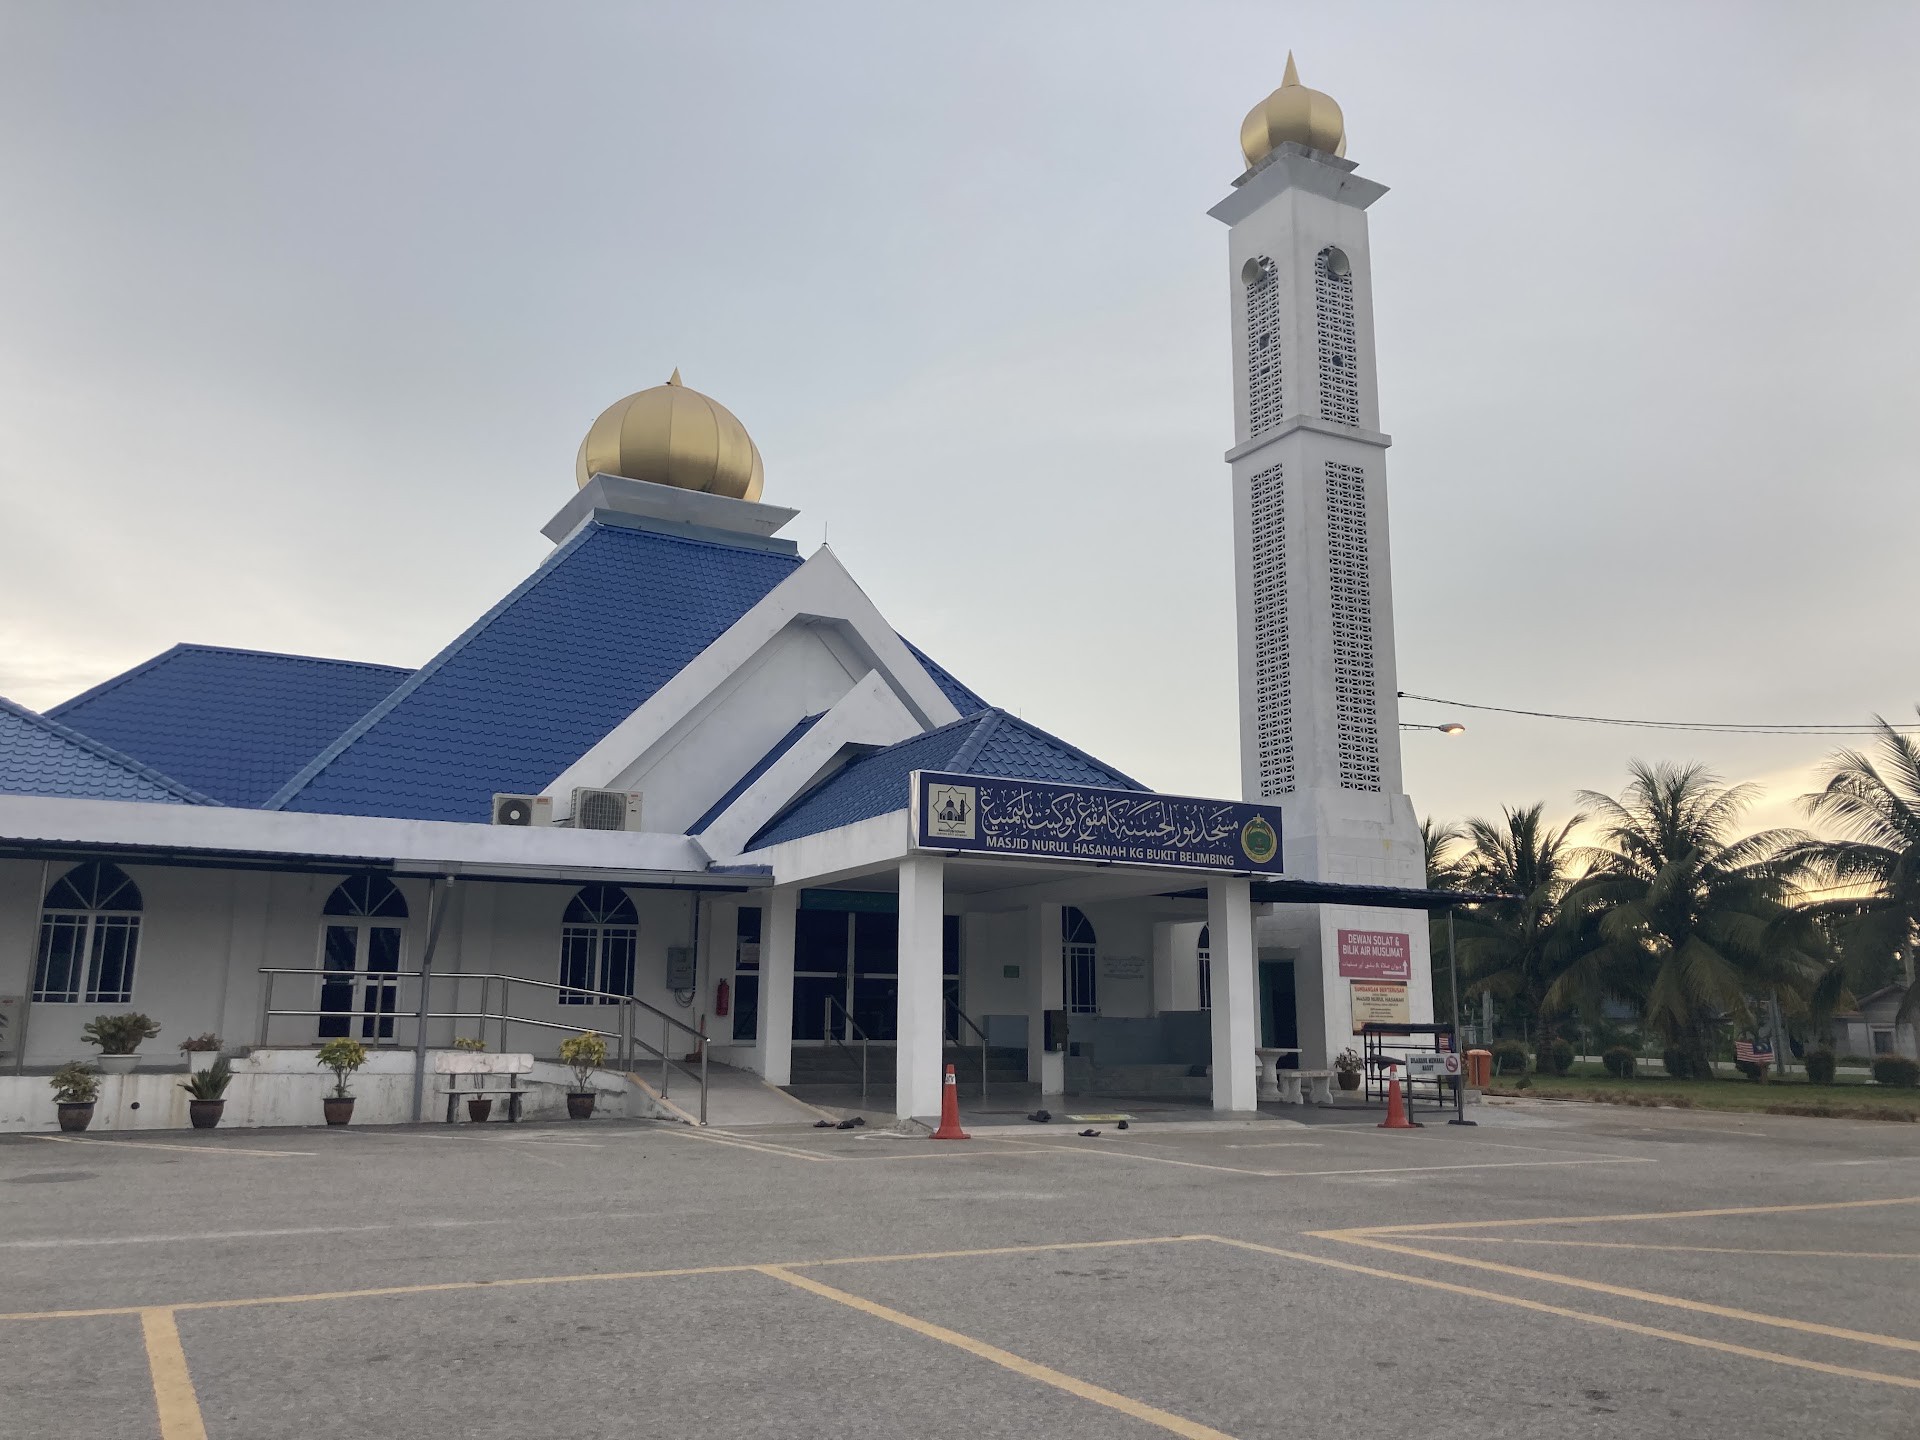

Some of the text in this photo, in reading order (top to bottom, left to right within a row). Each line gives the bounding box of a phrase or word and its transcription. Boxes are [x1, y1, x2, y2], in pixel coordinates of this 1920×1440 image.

[986, 835, 1235, 866] MASJID NURUL HASANAH KG BUKIT BELIMBING
[1348, 933, 1400, 947] DEWAN SOLAT &
[1342, 944, 1404, 958] BILIK AIR MUSLIMAT
